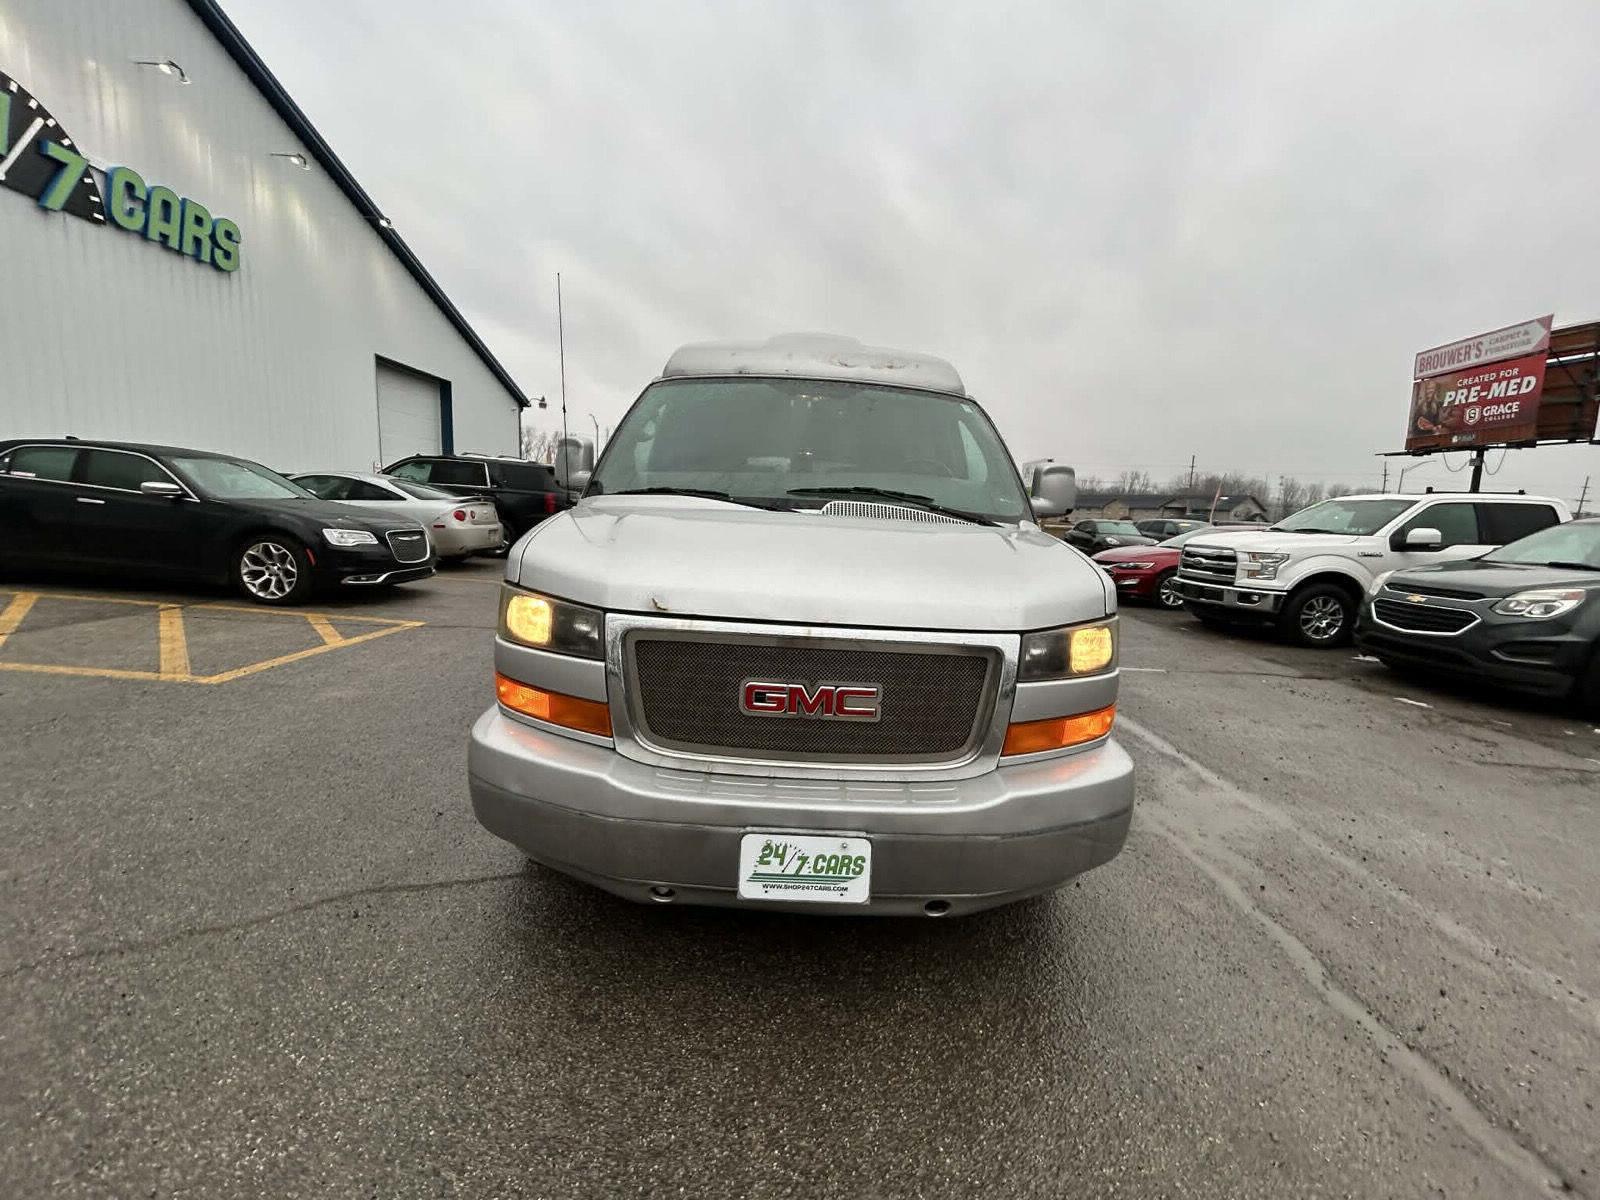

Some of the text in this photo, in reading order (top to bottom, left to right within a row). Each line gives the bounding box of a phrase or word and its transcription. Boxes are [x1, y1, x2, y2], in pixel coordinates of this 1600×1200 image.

[105, 166, 241, 272] CARS
[1418, 342, 1484, 373] BROUWER'S
[1443, 375, 1537, 407] PRE-MED
[1457, 368, 1519, 387] CREATED FOR
[1482, 402, 1520, 417] GRACE
[1484, 413, 1516, 422] COLLEGE
[744, 681, 878, 718] GMC
[812, 853, 866, 876] CARS
